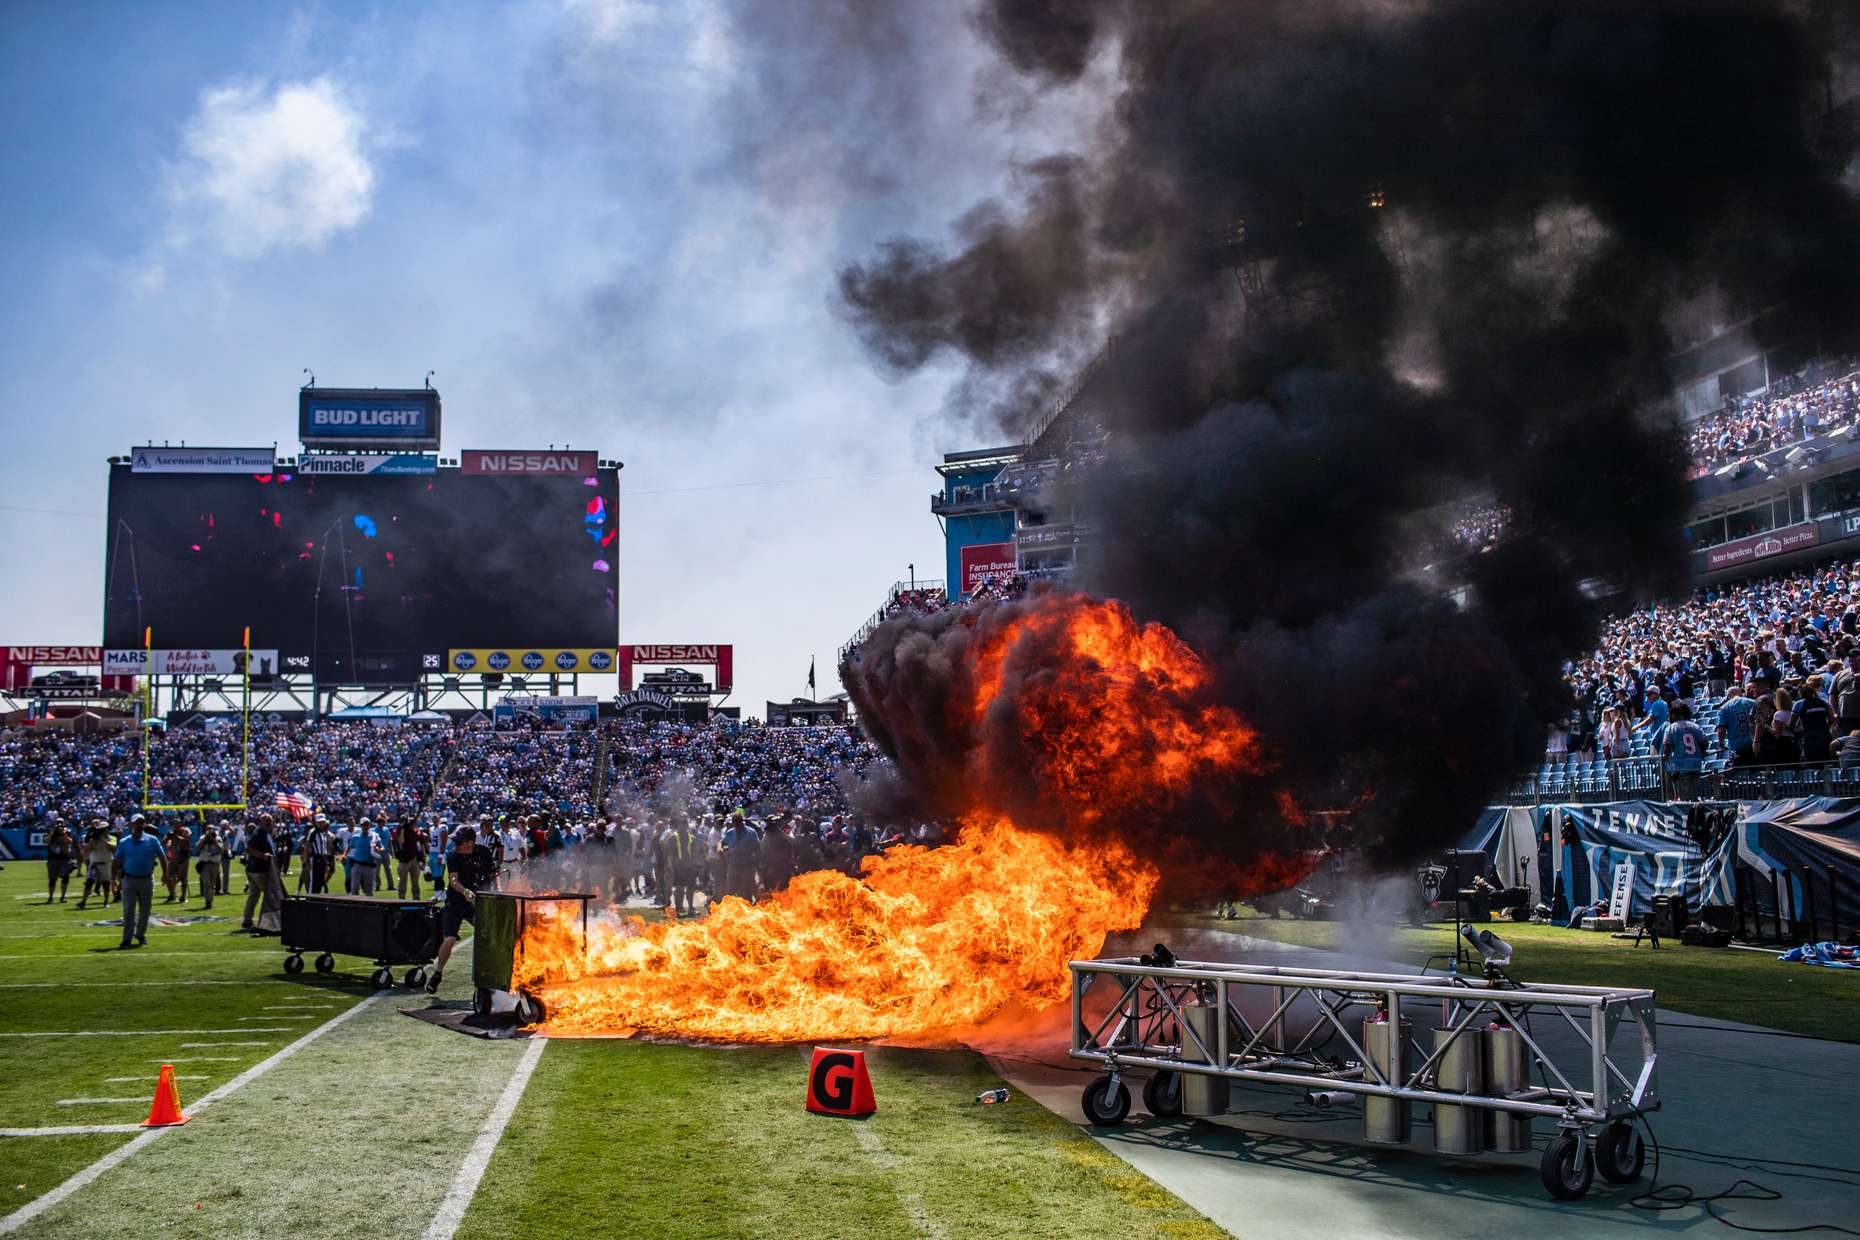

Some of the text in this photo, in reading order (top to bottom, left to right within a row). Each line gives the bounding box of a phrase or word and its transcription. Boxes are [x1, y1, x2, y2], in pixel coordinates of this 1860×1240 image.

[315, 410, 419, 425] BUD LIGHT
[154, 456, 273, 466] Ascension Saint Thomas
[301, 456, 364, 472] Pinnacle
[481, 456, 579, 471] NISSAN
[1783, 535, 1799, 545] Better
[969, 561, 1016, 572] Farm Bureau
[9, 647, 100, 661] NISSAN
[107, 651, 148, 663] MARS
[633, 646, 718, 659] NISSAN
[424, 656, 438, 667] 25
[455, 654, 475, 668] Kroger
[489, 654, 508, 668] Kroger
[523, 654, 542, 668] Kroger
[557, 654, 577, 668] Kroger
[591, 654, 610, 668] Kroger
[41, 689, 95, 697] TITAN
[660, 685, 708, 693] TITAN
[613, 692, 637, 710] JACK
[1682, 733, 1696, 755] 9
[1613, 865, 1628, 917] EFENSE
[812, 1053, 855, 1110] G
